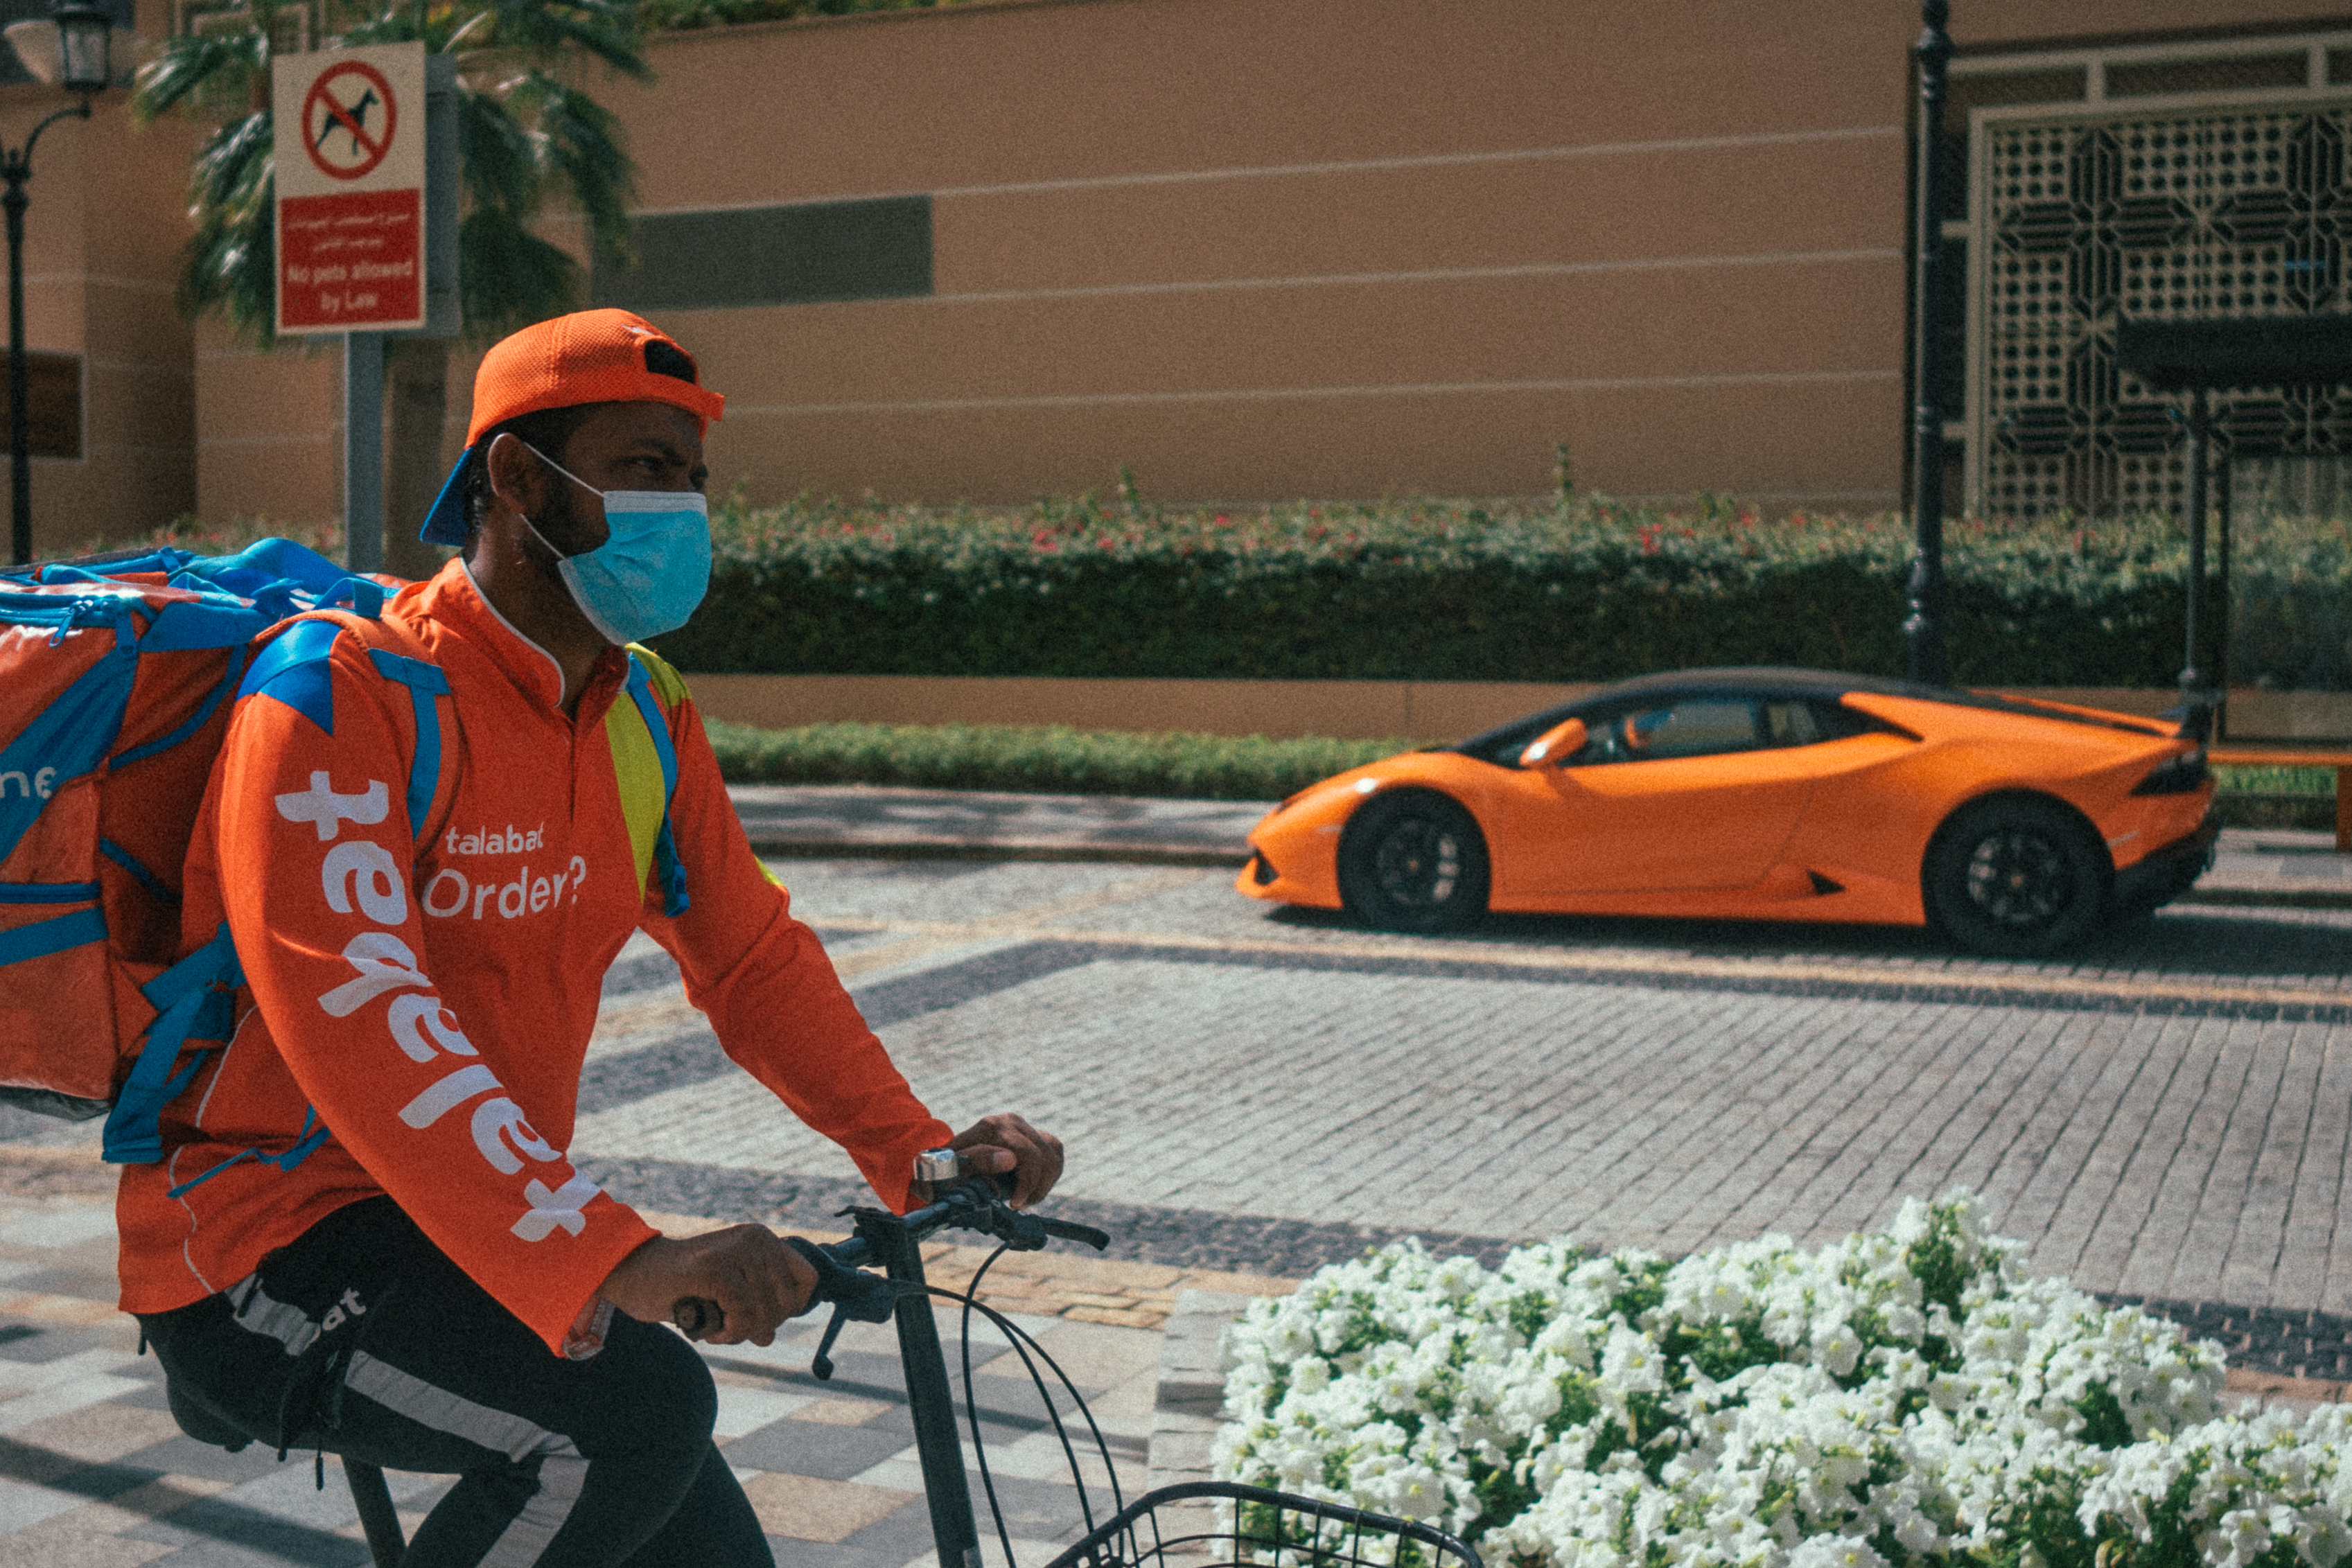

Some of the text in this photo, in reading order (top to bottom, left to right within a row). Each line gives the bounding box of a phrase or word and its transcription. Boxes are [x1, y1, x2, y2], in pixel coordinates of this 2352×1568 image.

[446, 821, 544, 854] talabat
[422, 856, 586, 919] Order?
[275, 770, 602, 1242] talabat
